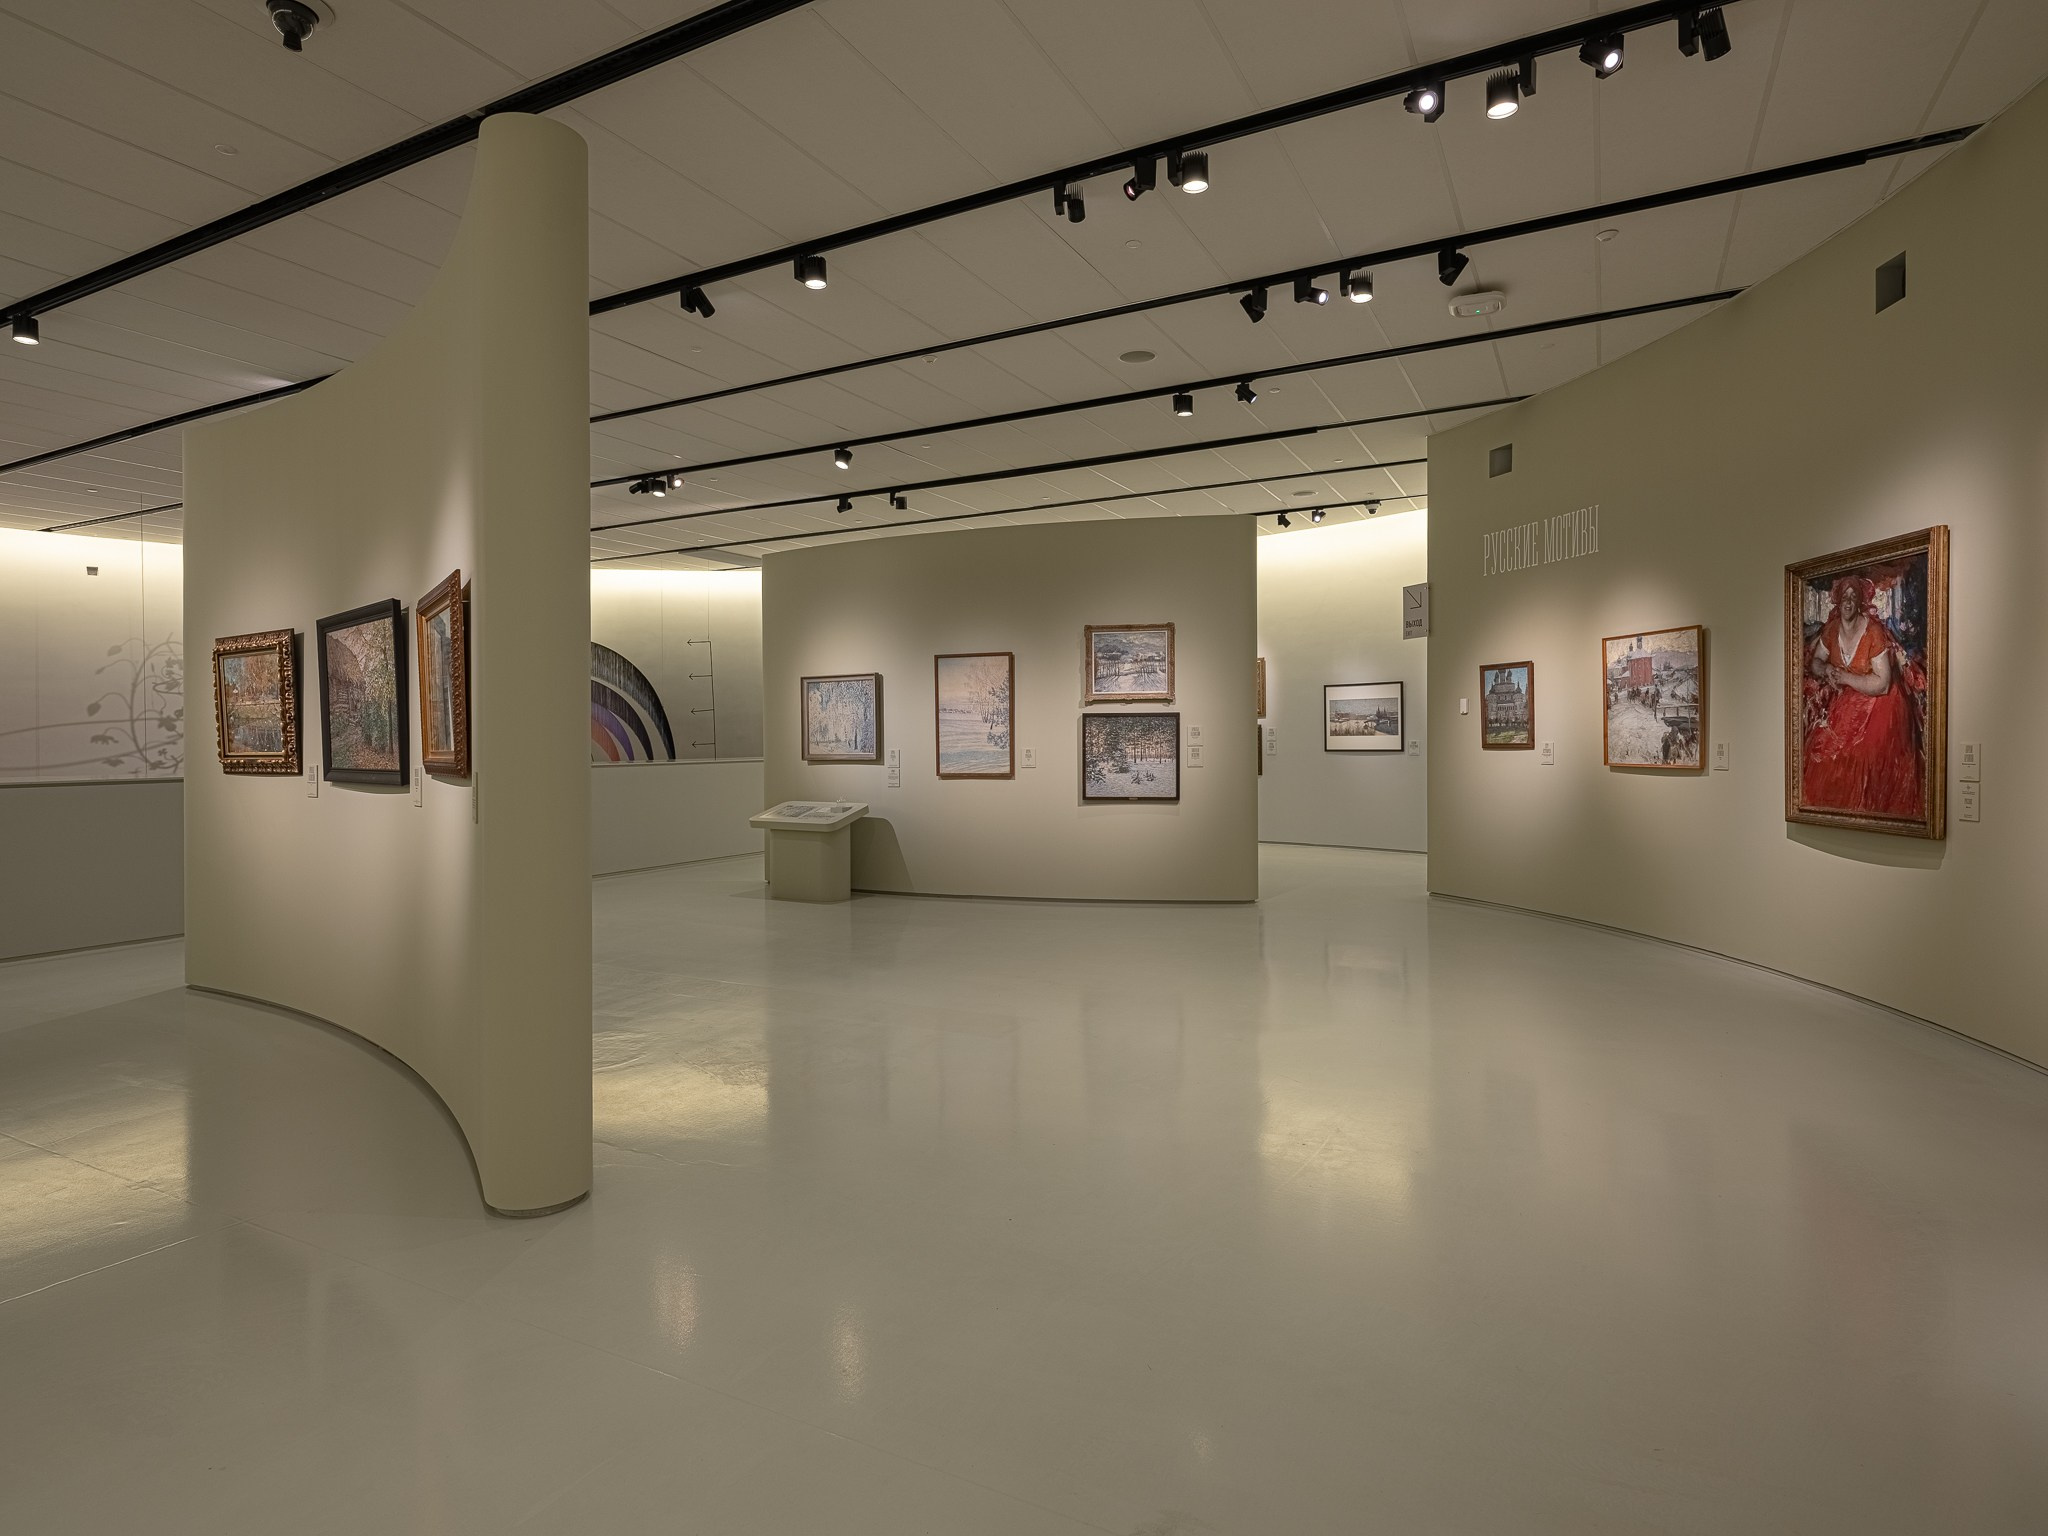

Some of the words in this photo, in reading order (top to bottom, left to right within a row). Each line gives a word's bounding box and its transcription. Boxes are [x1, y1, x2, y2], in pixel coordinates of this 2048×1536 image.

[1483, 521, 1539, 576] РУССКИЕ
[1543, 504, 1599, 564] МОТИВЫ
[1405, 618, 1423, 628] ВЫХОД
